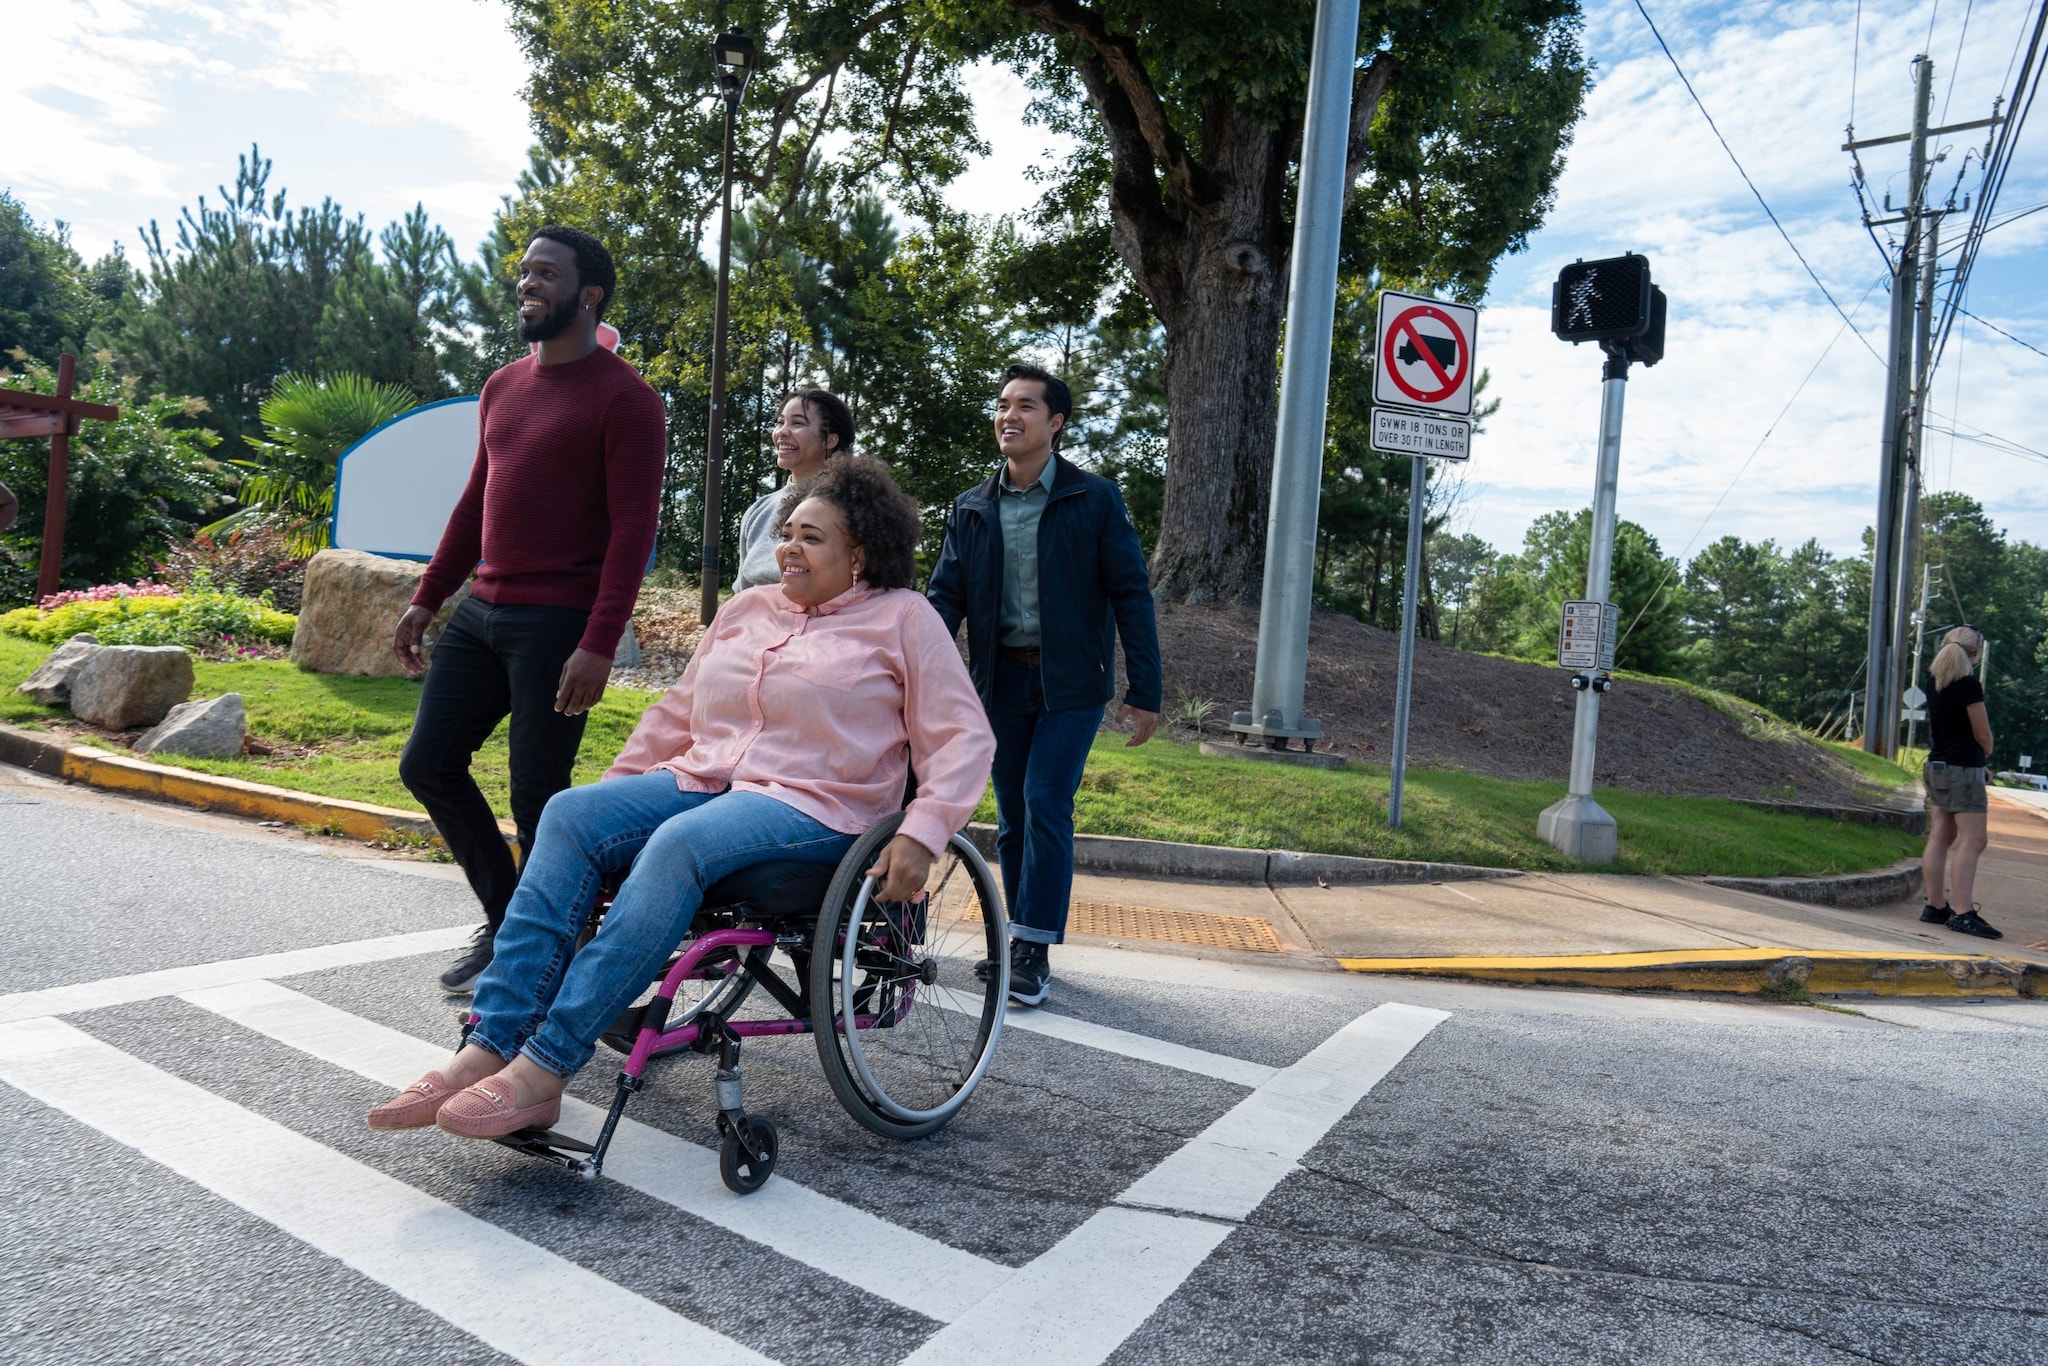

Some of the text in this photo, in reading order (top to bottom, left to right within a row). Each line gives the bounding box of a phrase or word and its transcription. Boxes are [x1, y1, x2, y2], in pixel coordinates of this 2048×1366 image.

[1380, 417, 1464, 438] GVWR 18 TONS OR
[1379, 431, 1464, 453] OVER 30 FT IN LENGTH
